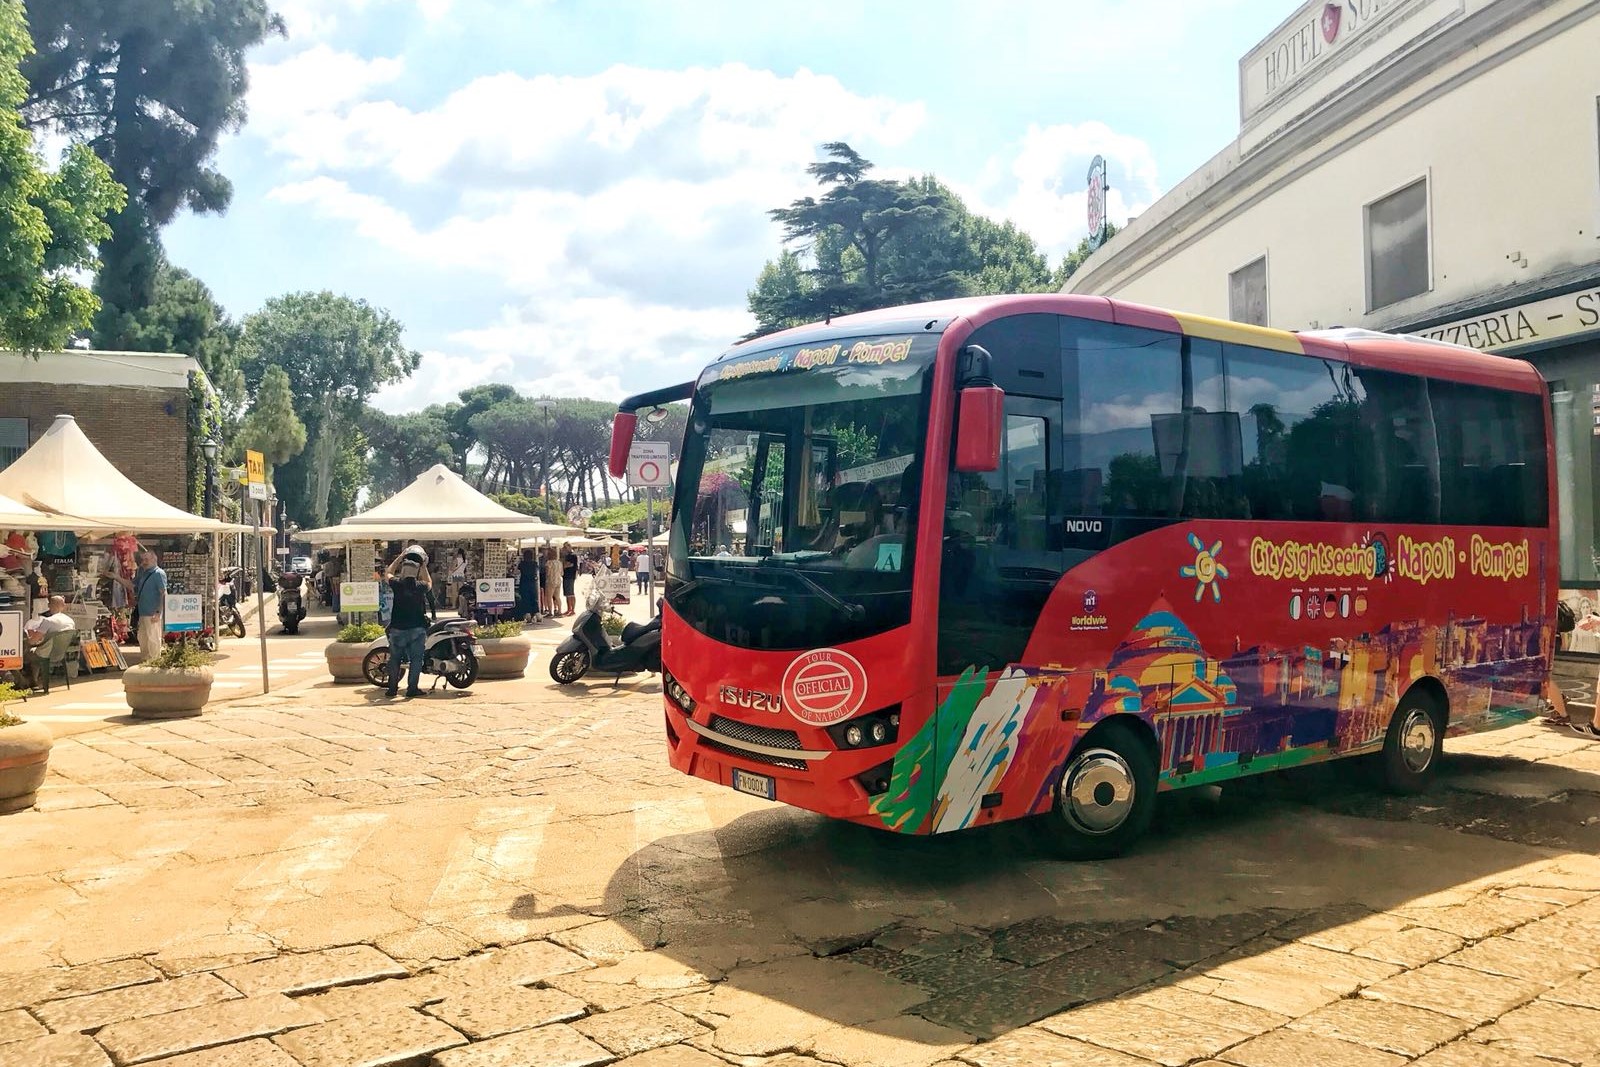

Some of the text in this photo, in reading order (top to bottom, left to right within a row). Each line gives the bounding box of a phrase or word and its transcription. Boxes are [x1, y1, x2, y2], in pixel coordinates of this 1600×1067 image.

[1264, 19, 1321, 95] HOTEL
[794, 344, 842, 370] Napoli
[849, 338, 912, 365] Pompei
[249, 459, 264, 476] TAXI
[1066, 520, 1102, 533] NOVO
[882, 552, 896, 570] A
[1398, 534, 1455, 585] Napoli
[1471, 533, 1529, 582] Pompei
[804, 652, 832, 664] TOUR
[796, 677, 850, 696] OFFICIAL
[720, 684, 782, 714] ISUZU
[801, 704, 850, 722] OF NAPOLI
